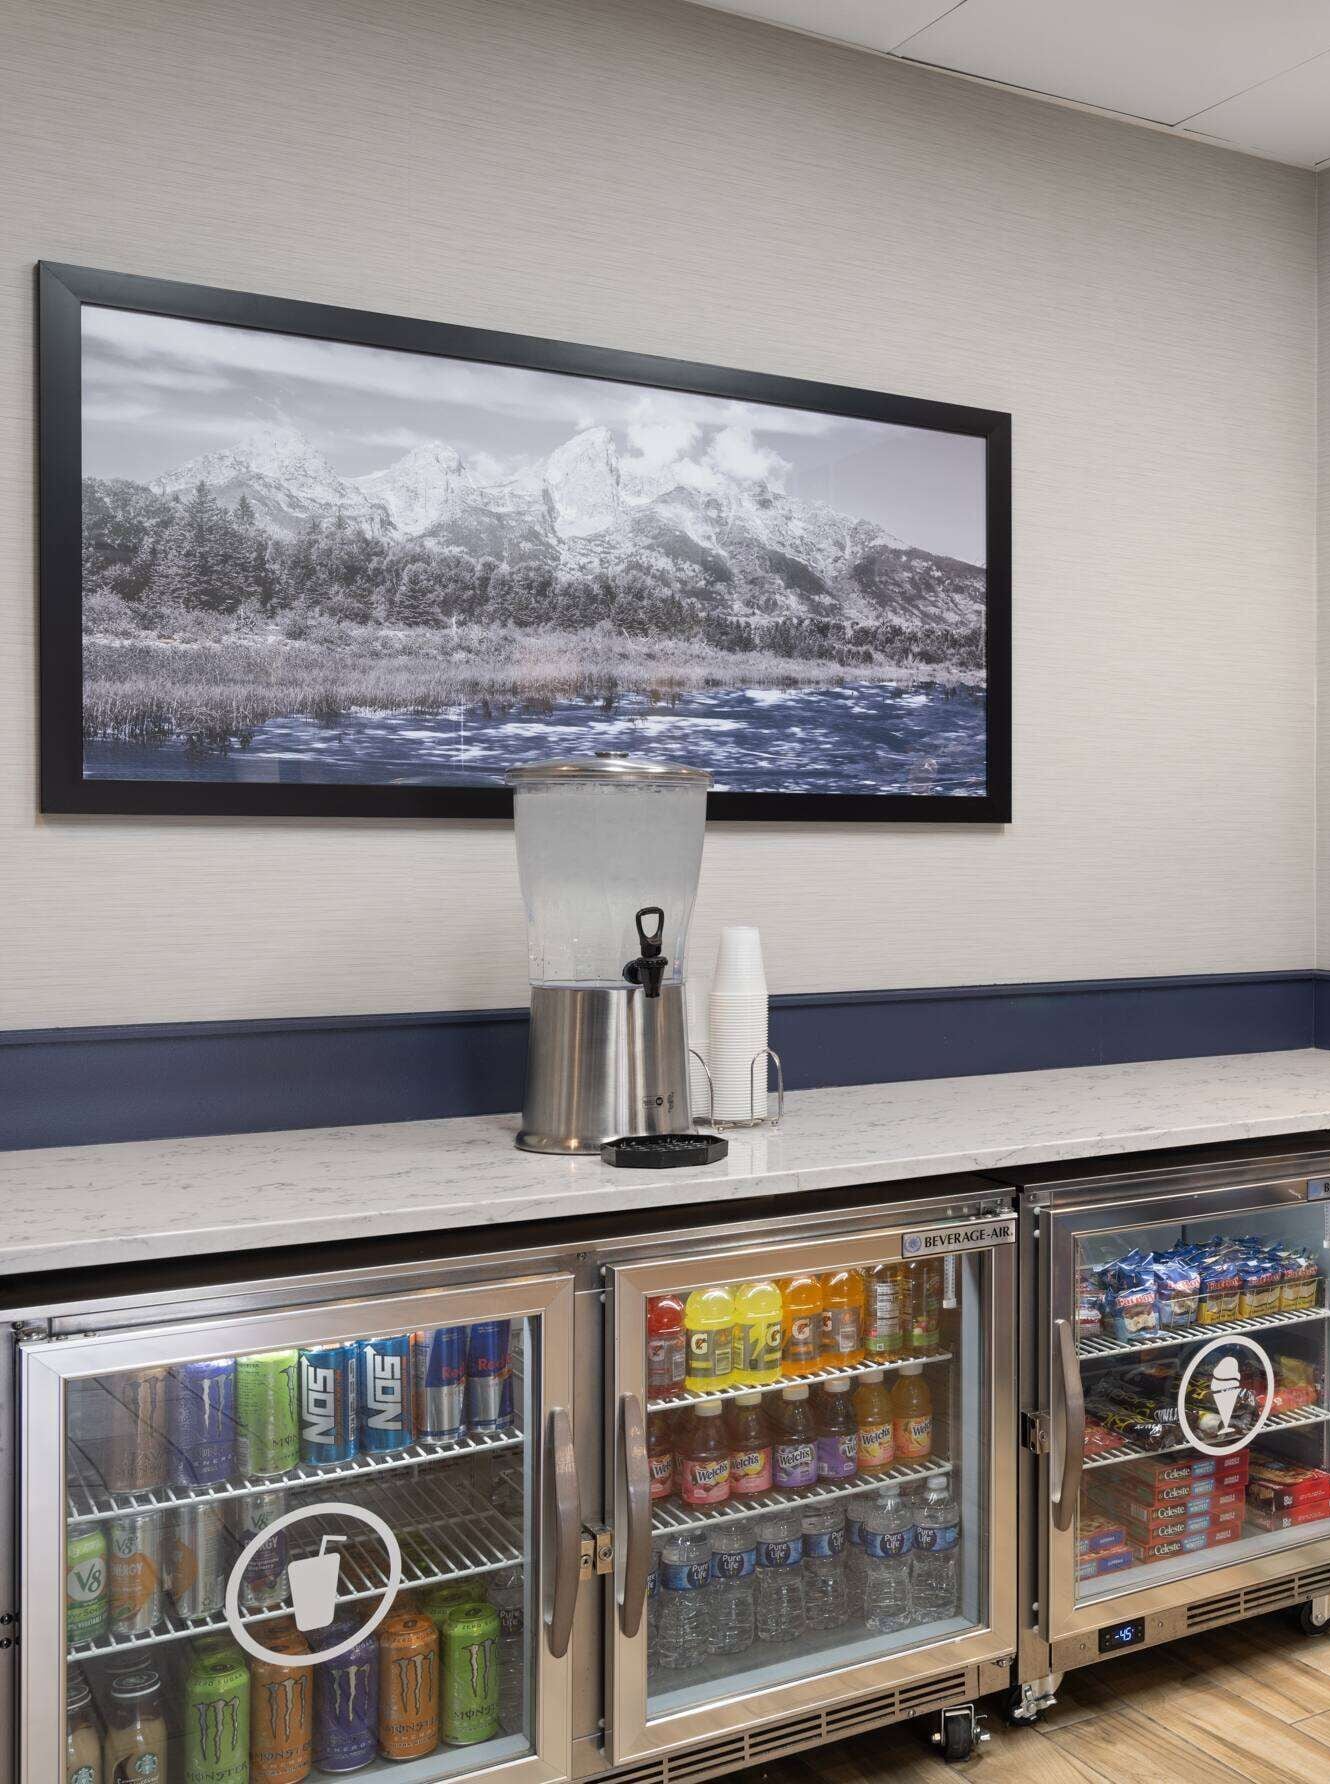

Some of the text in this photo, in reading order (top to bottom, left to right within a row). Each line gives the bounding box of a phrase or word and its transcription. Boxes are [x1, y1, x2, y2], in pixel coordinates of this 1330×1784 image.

[924, 1225, 1010, 1248] BEVERAGE-AIR
[363, 1346, 402, 1431] NOS
[301, 1357, 336, 1445] NOS
[861, 1427, 890, 1445] Welch's
[779, 1449, 811, 1466] Welch's
[697, 1460, 729, 1481] Welch's
[1164, 1467, 1191, 1480] Celeste
[1163, 1485, 1190, 1500] Celeste
[1158, 1505, 1186, 1518] Celeste
[1158, 1522, 1185, 1537] Celeste
[768, 1543, 788, 1551] Pure
[771, 1550, 786, 1559] Life
[1154, 1541, 1182, 1556] Celeste
[722, 1554, 741, 1563] Pure
[724, 1561, 739, 1570] Life
[74, 1561, 101, 1593] V8
